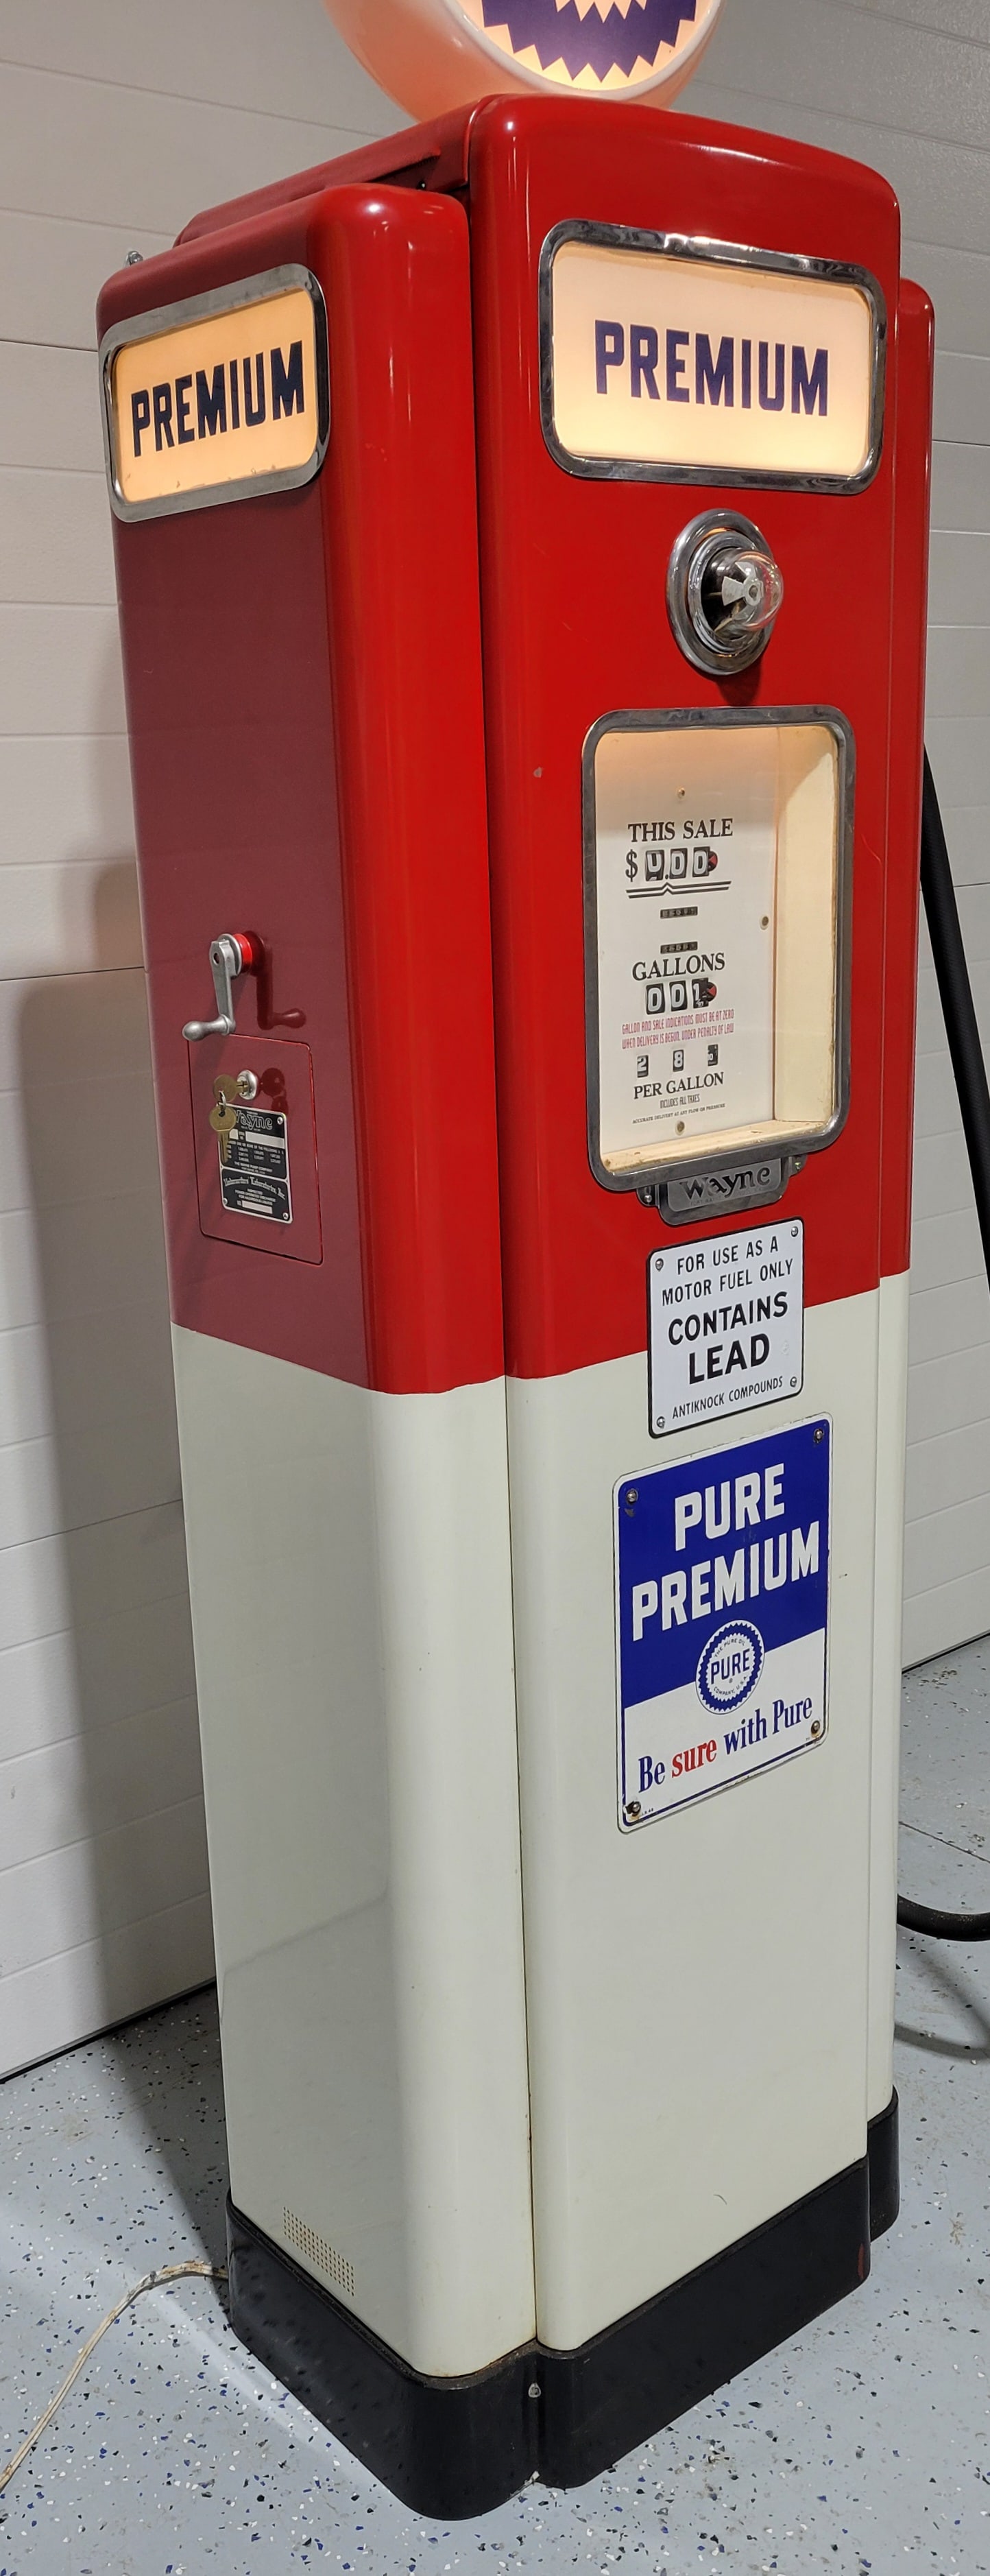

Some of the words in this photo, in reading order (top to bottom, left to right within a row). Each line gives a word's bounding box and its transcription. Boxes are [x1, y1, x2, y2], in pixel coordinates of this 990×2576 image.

[595, 319, 829, 417] PREMIUM
[131, 340, 304, 457] PREMIUM
[627, 822, 675, 843] THIS
[682, 818, 734, 839] SALE
[632, 952, 725, 981] GALLONS
[622, 1022, 640, 1034] GALLON
[641, 1021, 651, 1031] AND
[653, 1018, 664, 1030] SALE
[665, 1014, 694, 1028] INDICATIONS
[695, 1012, 708, 1024] MUST
[709, 1011, 715, 1022] BE
[716, 1010, 722, 1021] AT
[723, 1009, 734, 1020] ZERO
[622, 1037, 636, 1049] WHEN
[637, 1034, 659, 1047] DELIVERY
[660, 1033, 664, 1044] IS
[681, 1029, 697, 1040] UNDER
[697, 1025, 717, 1037] PENALTY
[718, 1025, 723, 1034] OF
[637, 1056, 647, 1072] 2
[673, 1051, 684, 1068] 8
[633, 1082, 662, 1099] PER
[666, 1071, 724, 1094] GALLON
[660, 1097, 679, 1109] INCLUDES
[679, 1167, 771, 1200] Wayne
[677, 1252, 705, 1275] FOR
[713, 1245, 738, 1267] USE
[745, 1239, 763, 1259] AS
[770, 1235, 778, 1252] A
[662, 1278, 712, 1307] MOTOR
[720, 1269, 752, 1292] FUEL
[760, 1259, 793, 1282] ONLY
[668, 1291, 788, 1346] CONTAINS
[688, 1333, 771, 1385] LEAD
[672, 1392, 725, 1420] ANTIKNOCK
[729, 1375, 784, 1402] COMPOUNDS
[674, 1462, 786, 1552] PURE
[631, 1520, 820, 1642] PREMIUM
[710, 1648, 751, 1685] PURE
[714, 1647, 723, 1658] THE
[723, 1638, 738, 1647] PURE
[638, 1754, 666, 1793] Be
[671, 1739, 718, 1779] sure
[724, 1709, 768, 1756] with
[771, 1697, 813, 1735] Pure
